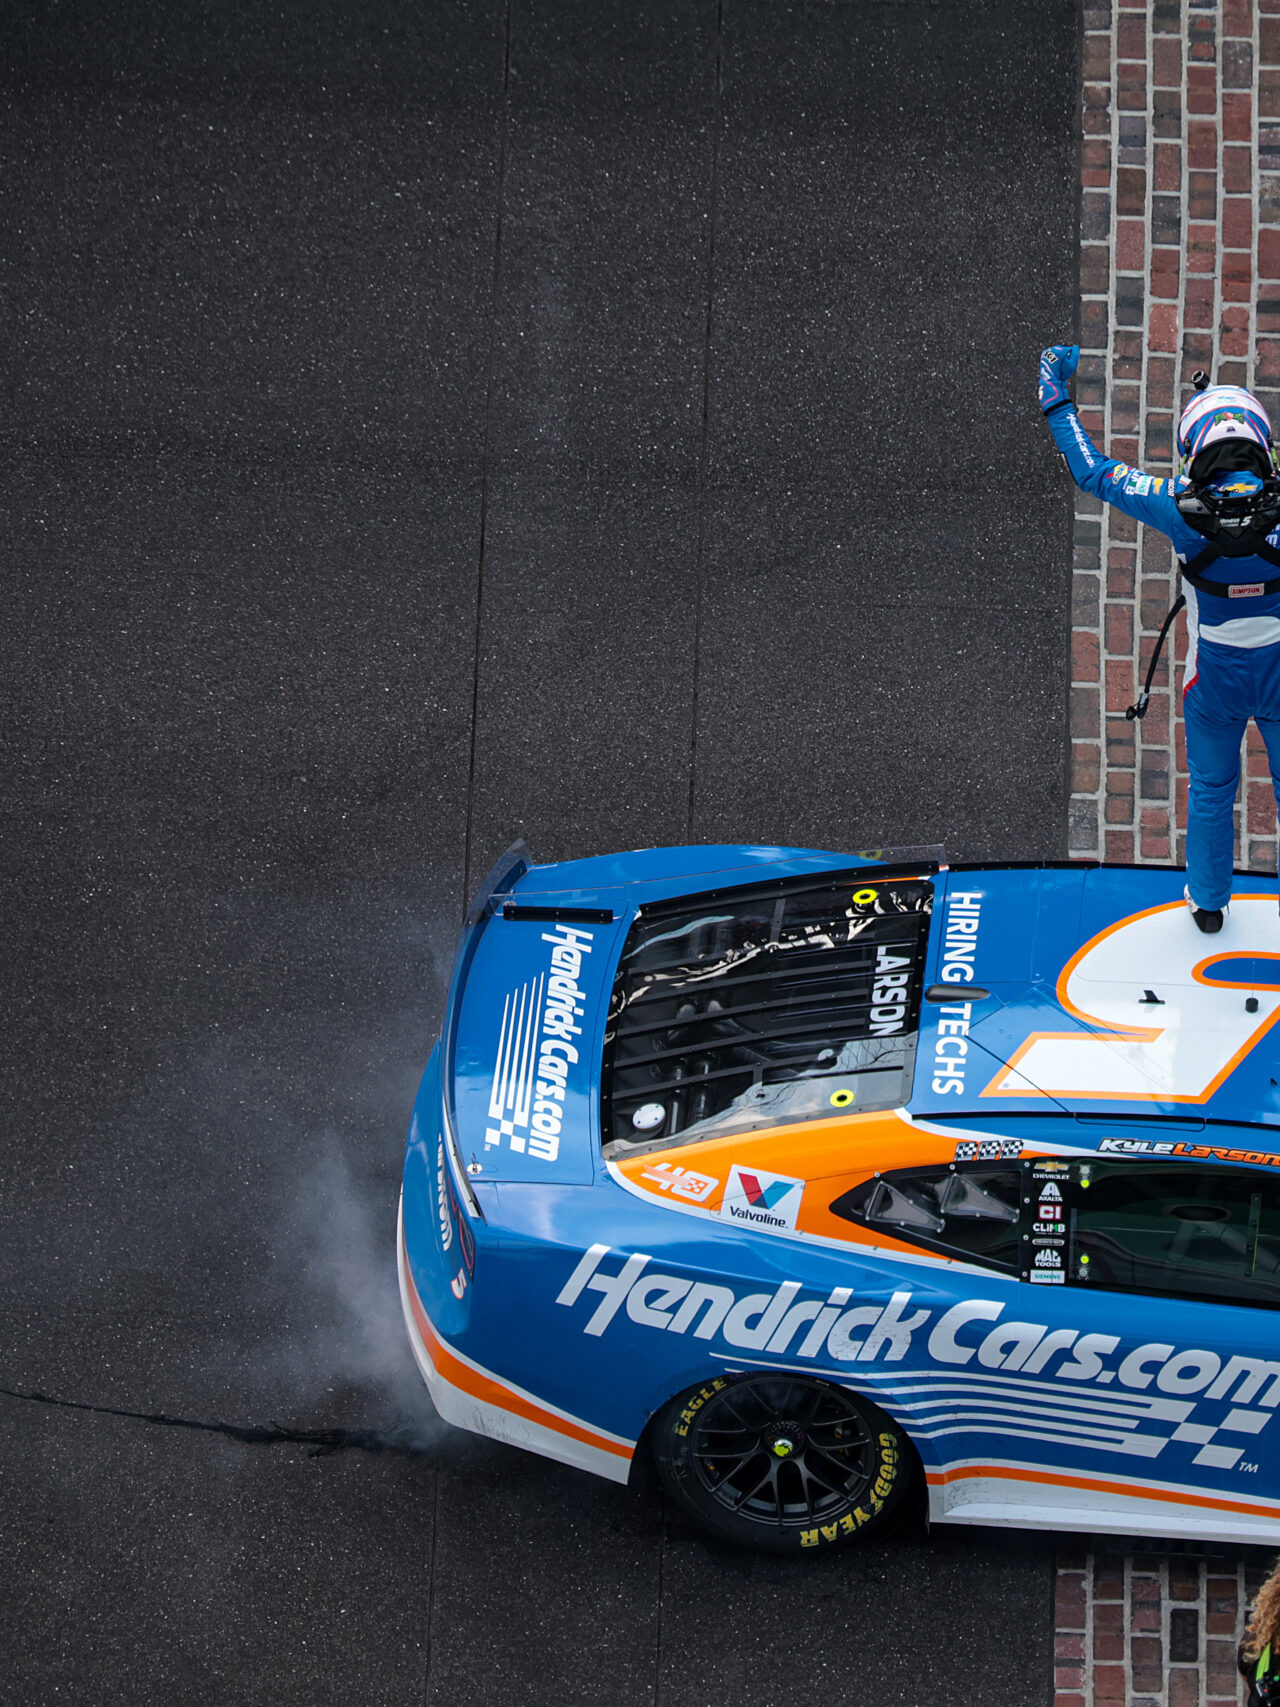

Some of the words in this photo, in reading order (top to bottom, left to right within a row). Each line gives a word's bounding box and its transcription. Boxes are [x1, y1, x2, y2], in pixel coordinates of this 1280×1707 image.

[941, 892, 983, 983] HIRING
[931, 1003, 972, 1096] TECHS
[730, 1206, 786, 1228] Valvoline
[1034, 1249, 1062, 1263] MAC
[672, 1377, 727, 1437] EAGLE
